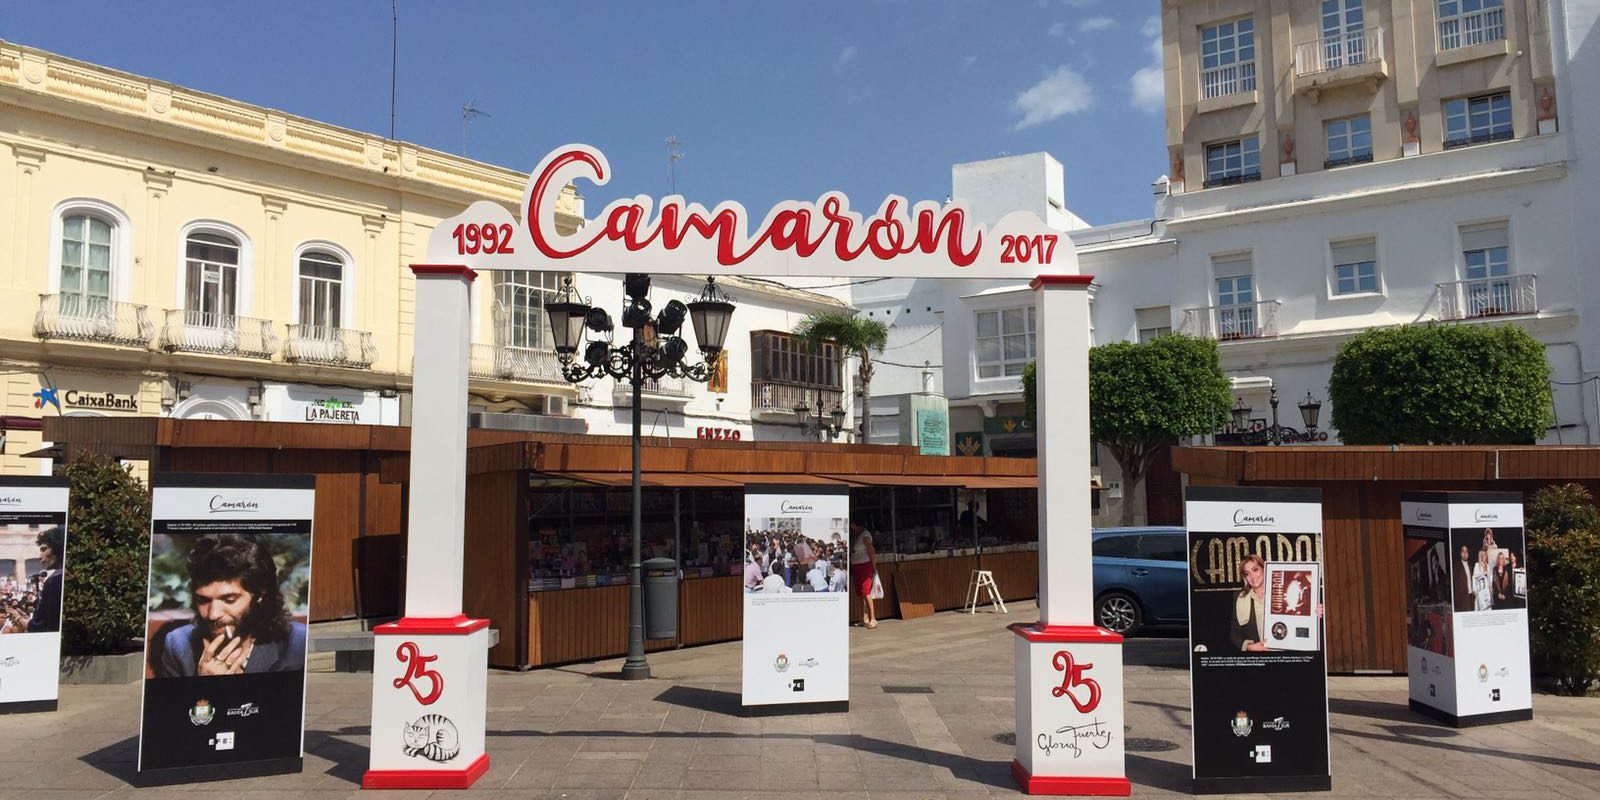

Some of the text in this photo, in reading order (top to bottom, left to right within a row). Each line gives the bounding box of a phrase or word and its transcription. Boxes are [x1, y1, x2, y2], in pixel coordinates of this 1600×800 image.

[453, 151, 1058, 267] 1992 Camarón 2017
[65, 390, 138, 409] CaixaBank
[306, 407, 360, 424] LA PAJERETA
[209, 495, 260, 511] Camarón
[1233, 509, 1275, 524] Camarón
[393, 641, 444, 705] 25
[1052, 650, 1102, 714] 25
